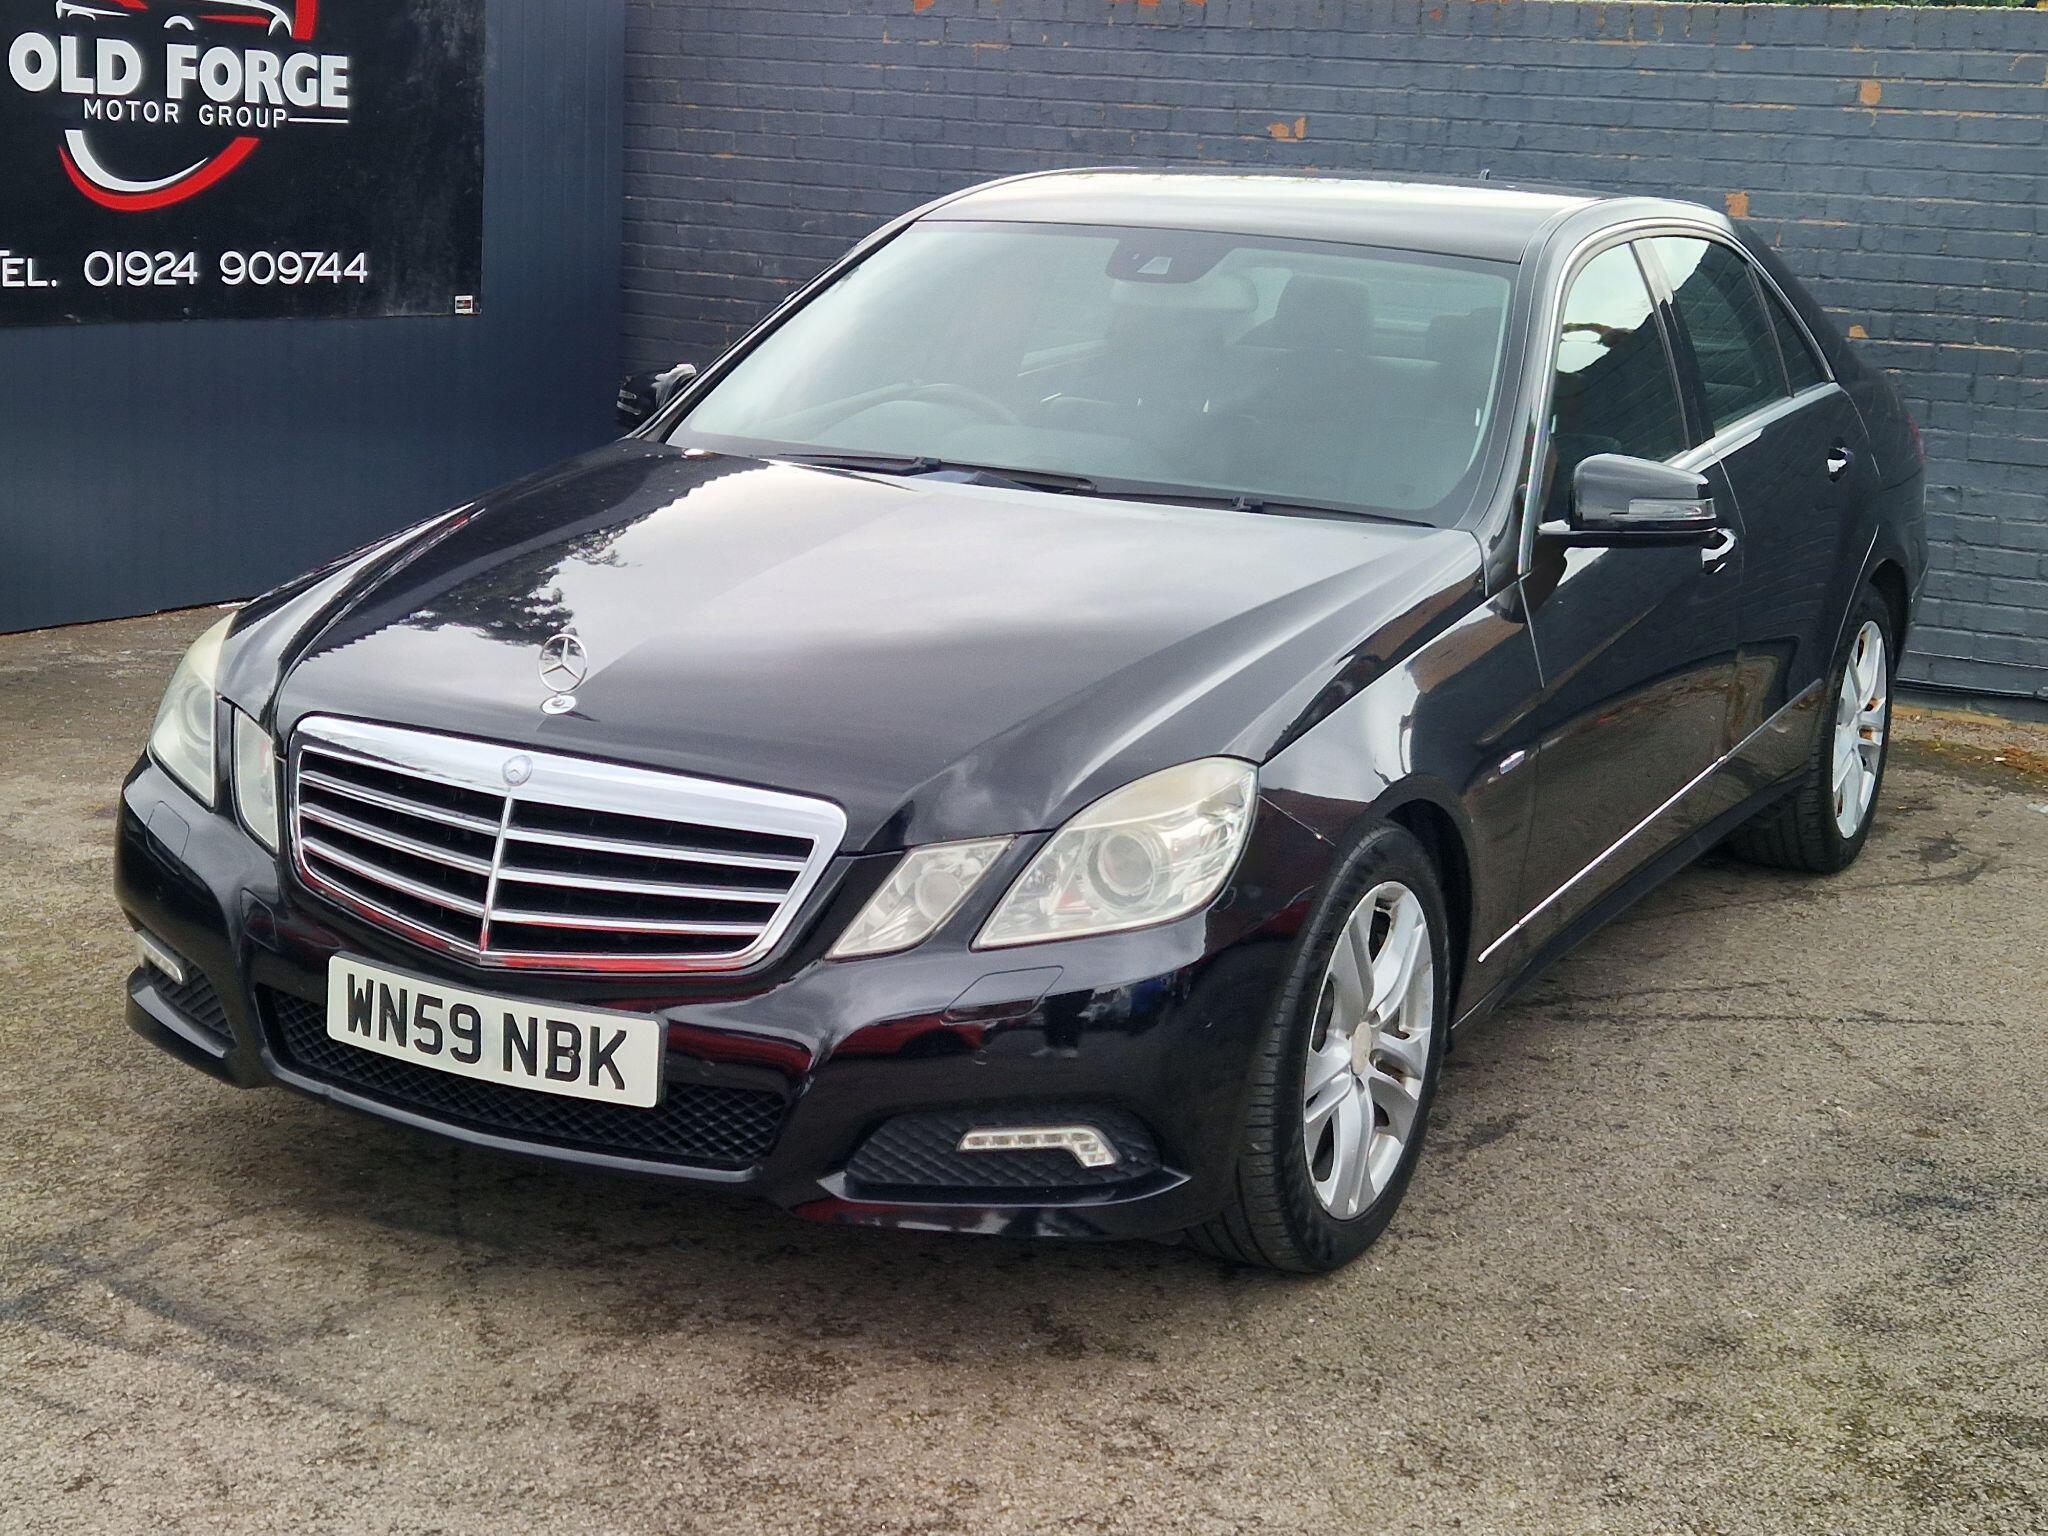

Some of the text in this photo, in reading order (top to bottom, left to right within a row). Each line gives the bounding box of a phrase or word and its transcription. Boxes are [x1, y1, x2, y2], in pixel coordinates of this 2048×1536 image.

[8, 32, 350, 109] OLD FORGE
[83, 98, 288, 129] MOTOR GROUP
[83, 250, 200, 287] 01924
[219, 250, 369, 287] 909744
[346, 973, 627, 1091] WN59 NBK
